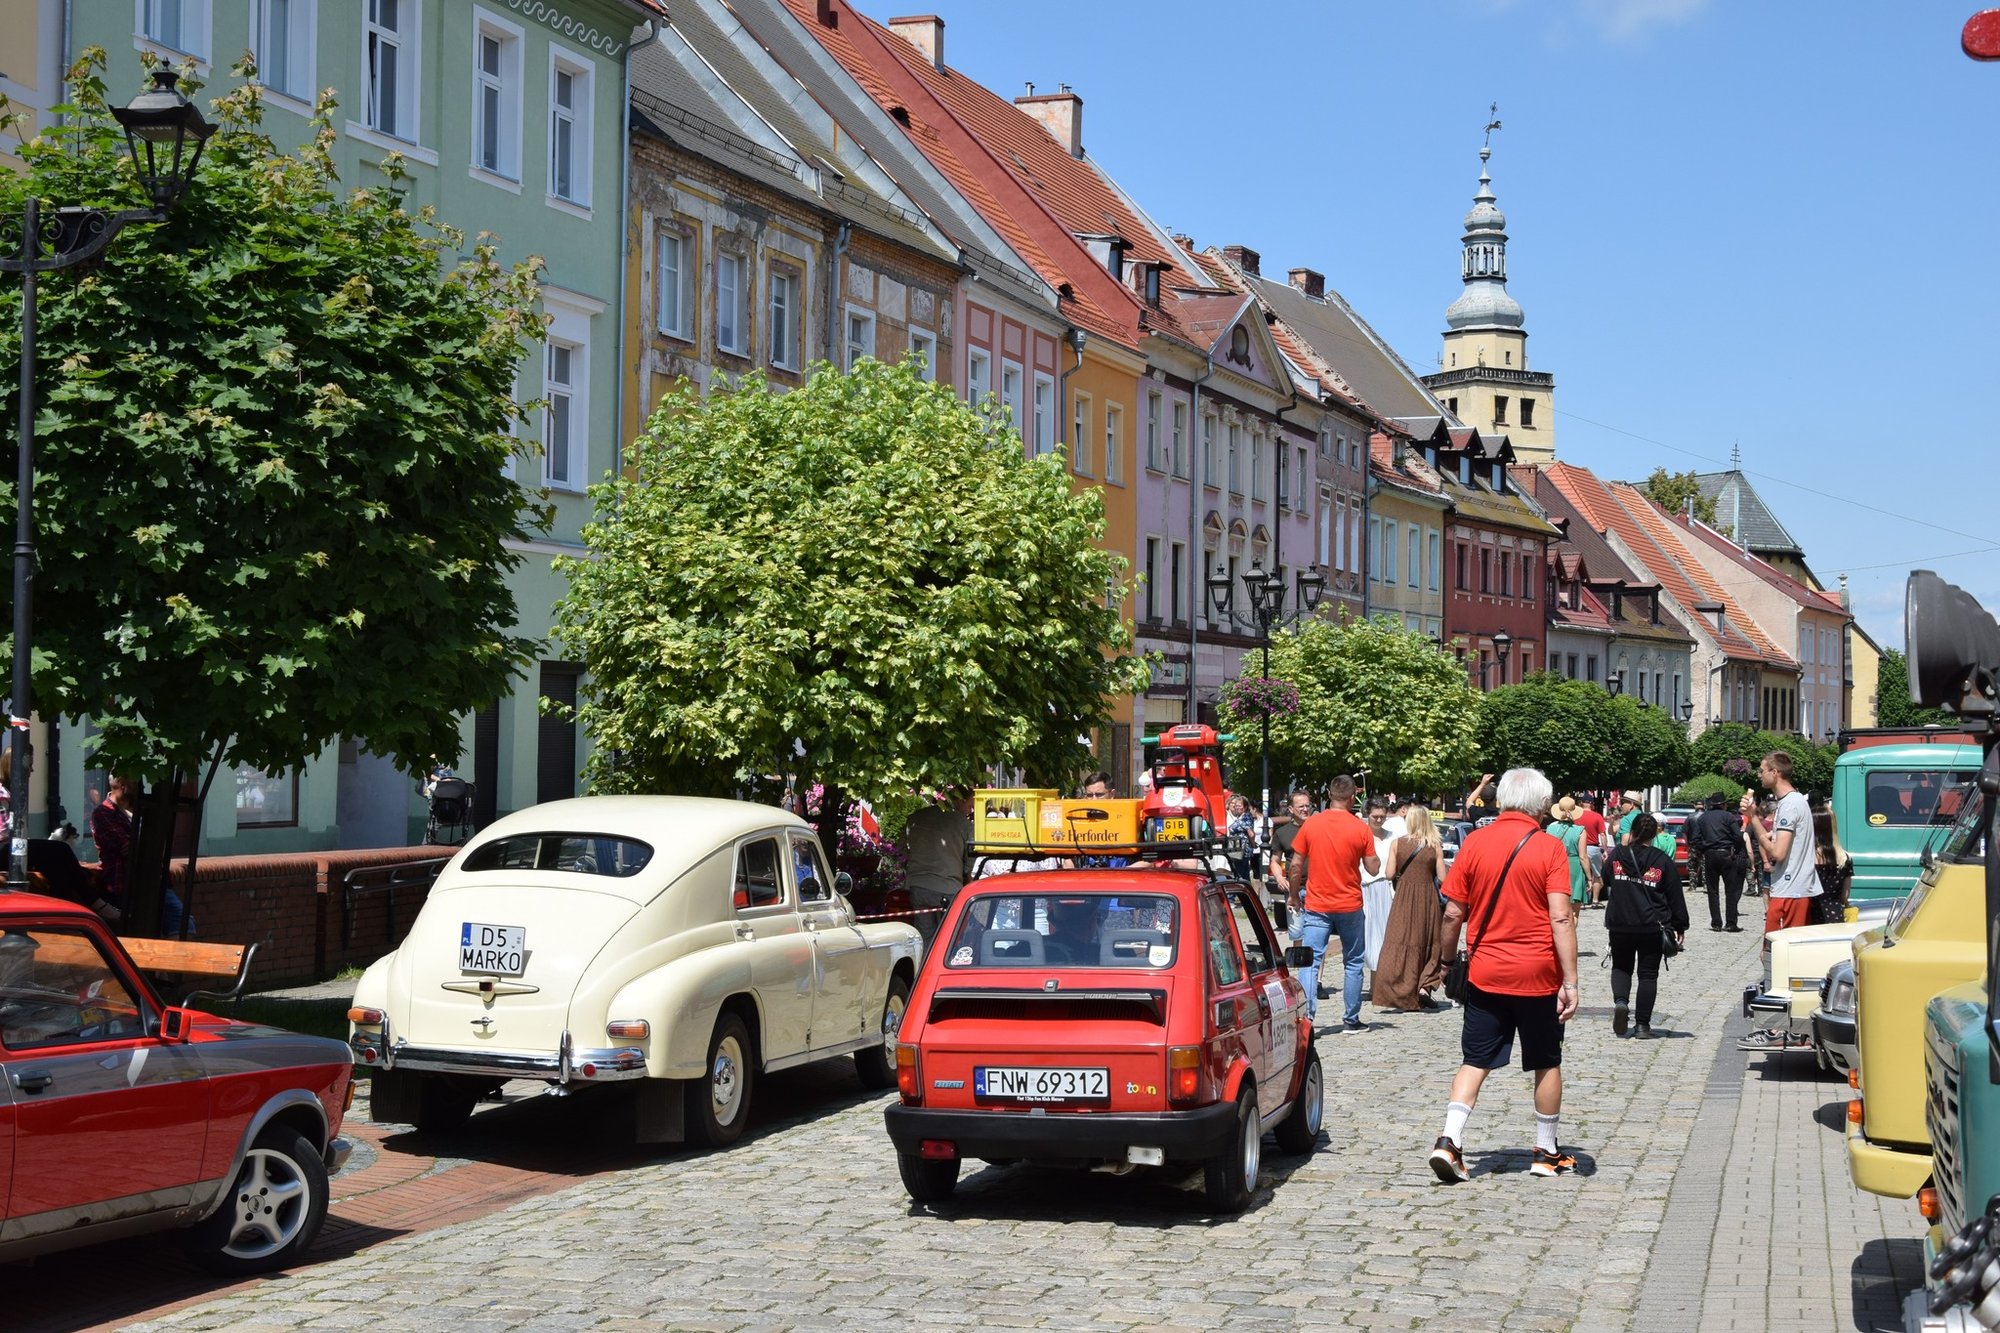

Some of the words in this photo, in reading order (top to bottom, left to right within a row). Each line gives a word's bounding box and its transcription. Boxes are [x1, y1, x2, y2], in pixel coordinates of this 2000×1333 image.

[1068, 829, 1120, 842] Herforder
[481, 927, 507, 947] D5
[462, 948, 521, 971] MARKO
[987, 1071, 1028, 1093] FNW
[1036, 1072, 1103, 1094] 69312
